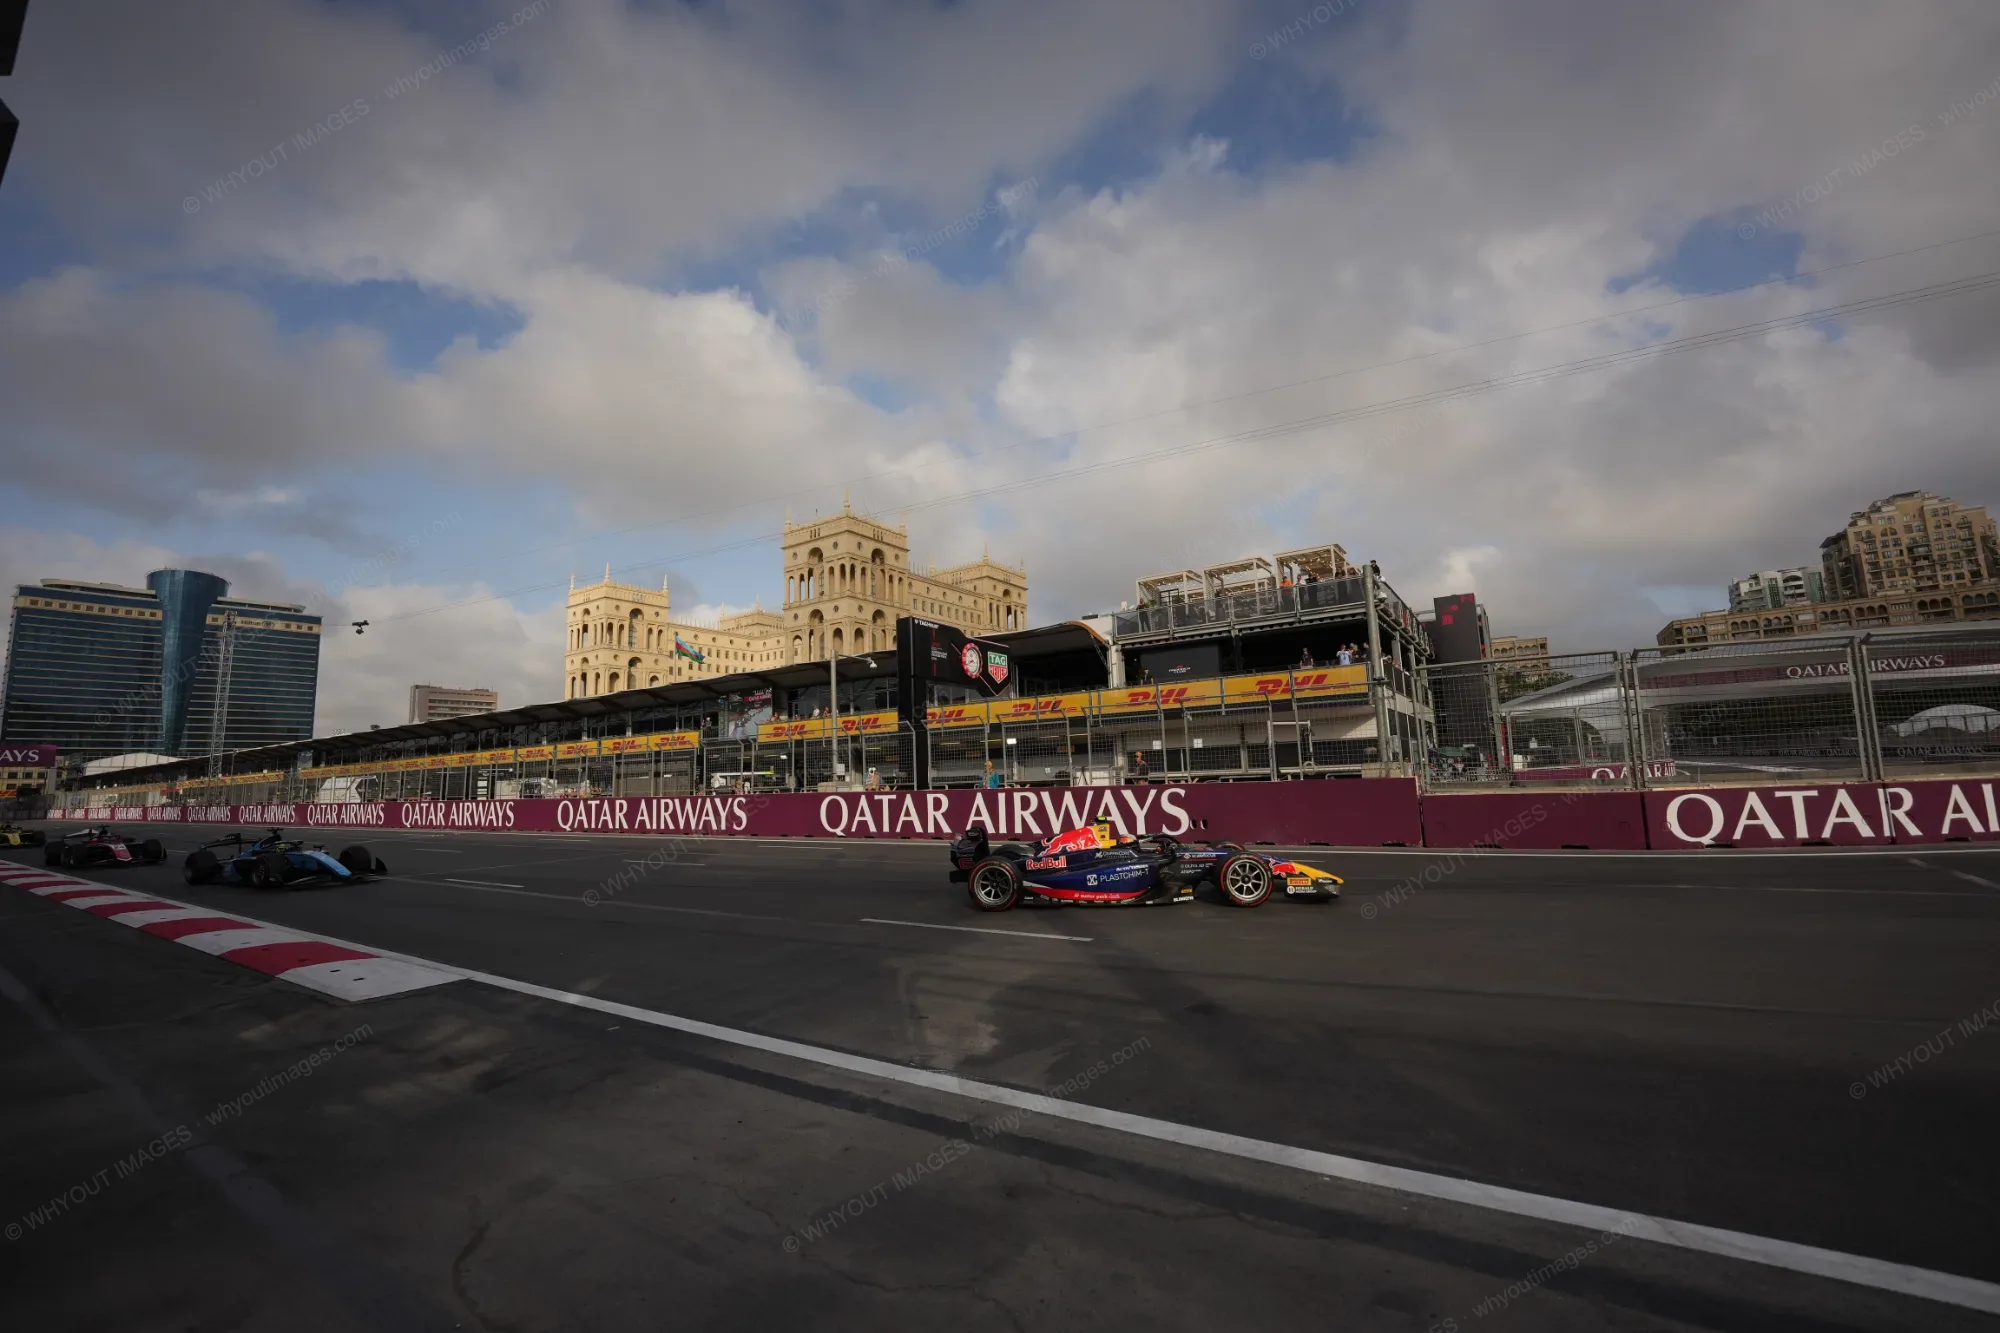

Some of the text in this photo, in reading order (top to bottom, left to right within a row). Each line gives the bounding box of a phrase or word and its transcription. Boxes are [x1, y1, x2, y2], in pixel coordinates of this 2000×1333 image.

[990, 655, 1006, 666] TAG
[1786, 655, 1945, 679] QATAR IRWAYS
[989, 666, 1007, 681] HEUER
[1255, 674, 1328, 693] DHL
[1128, 687, 1189, 704] DHL
[1013, 700, 1062, 716] DHL
[841, 717, 881, 731] DHL
[927, 709, 966, 725] DHL
[772, 724, 807, 737] DHL
[612, 740, 636, 750] DHL
[660, 735, 687, 746] DHL
[566, 744, 588, 754] DHL
[187, 806, 230, 822] QATAR AIRWAYS
[239, 805, 295, 823] QATAR AIRWAYS
[307, 803, 385, 825] QATAR AIRWAYS
[402, 801, 514, 827] QATAR AIRWAYS
[558, 797, 747, 831] QATAR AIRWAYS
[820, 788, 1190, 836] QATAR AIRWAYS
[1666, 784, 2000, 846] QATAR AI
[1026, 855, 1067, 870] Red Bull
[1099, 868, 1150, 882] PLASTCHIM-T
